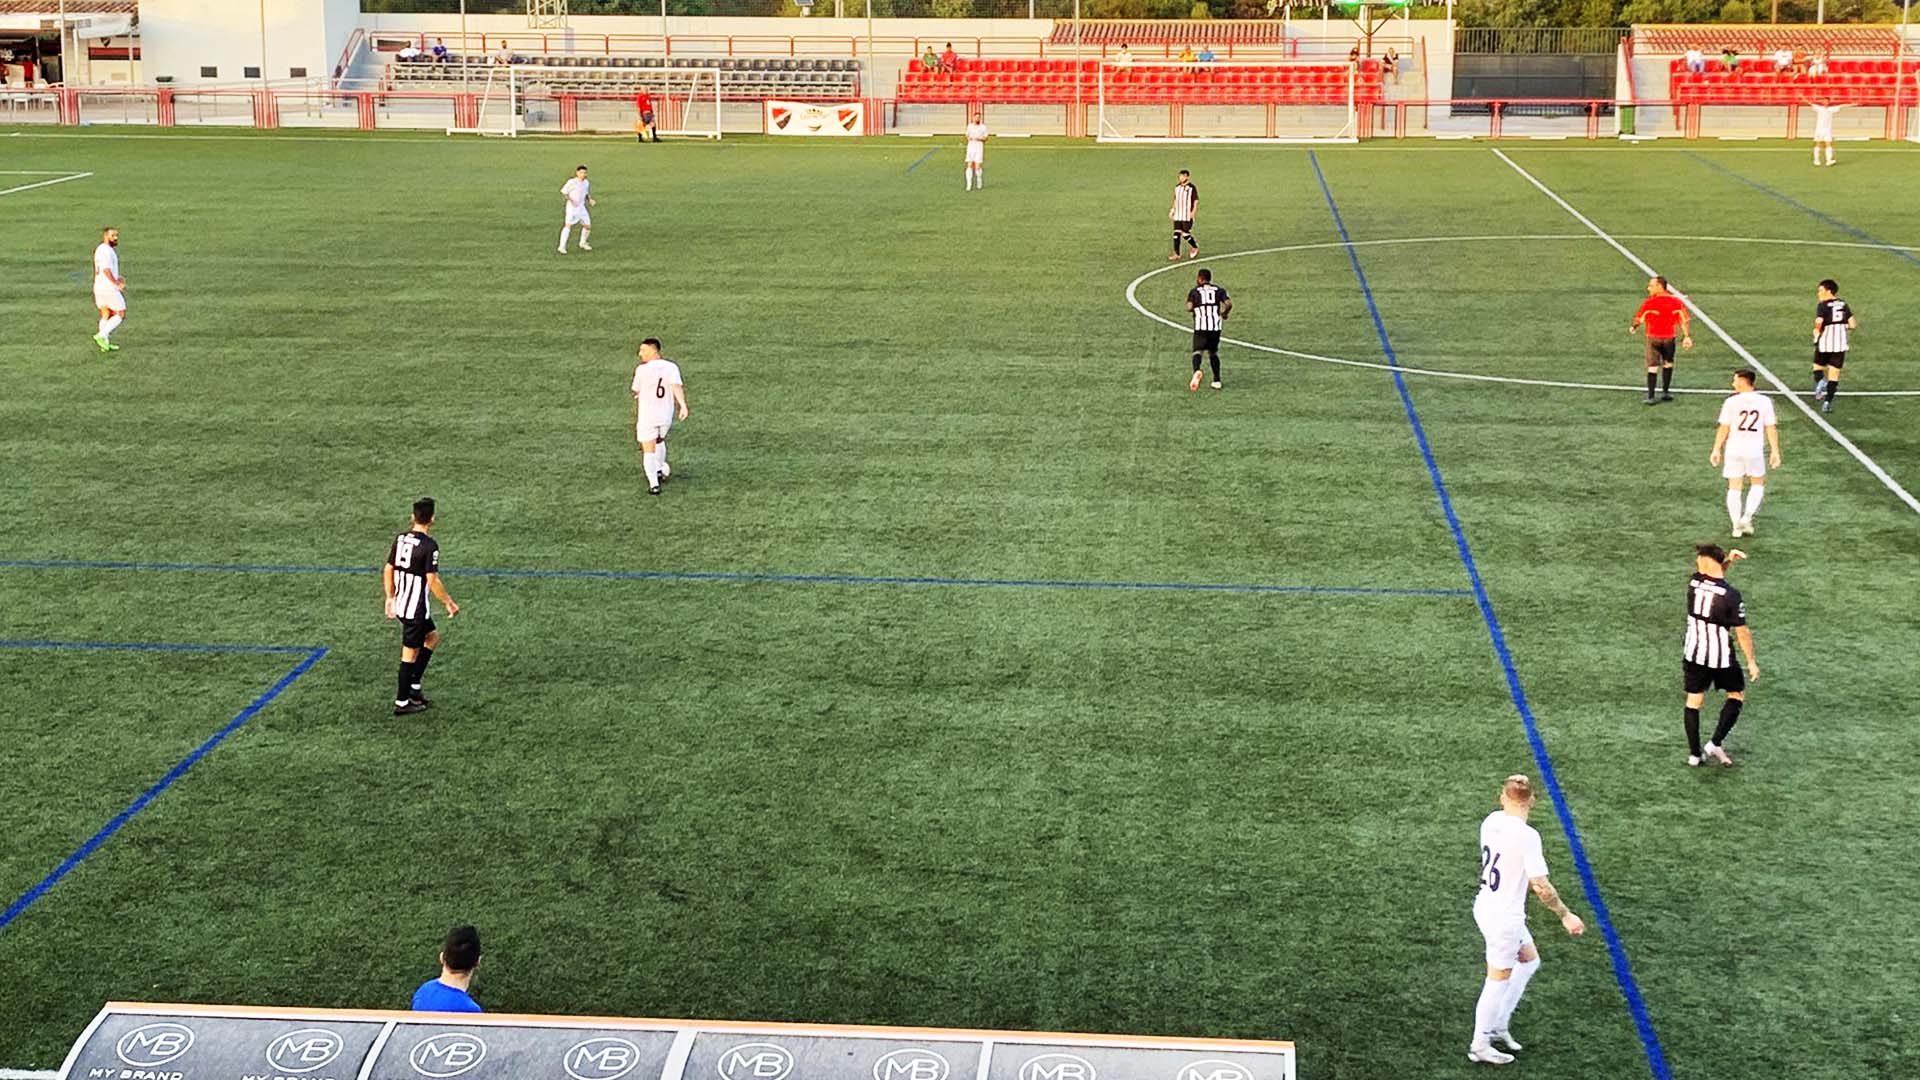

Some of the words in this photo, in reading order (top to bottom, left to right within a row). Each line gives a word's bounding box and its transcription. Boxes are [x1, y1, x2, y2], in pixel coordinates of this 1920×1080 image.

[1199, 290, 1216, 305] 10
[656, 377, 665, 399] 6
[1738, 409, 1760, 432] 22
[395, 541, 414, 569] 19
[1694, 588, 1714, 618] 11
[1480, 845, 1501, 892] 26
[126, 1031, 182, 1056] MB
[276, 1037, 332, 1062] MB
[419, 1041, 474, 1066] MB
[573, 1046, 629, 1071] MB
[727, 1052, 783, 1077] MB
[884, 1057, 939, 1080] MB
[88, 1068, 116, 1078] MY
[120, 1069, 184, 1080] BRAND
